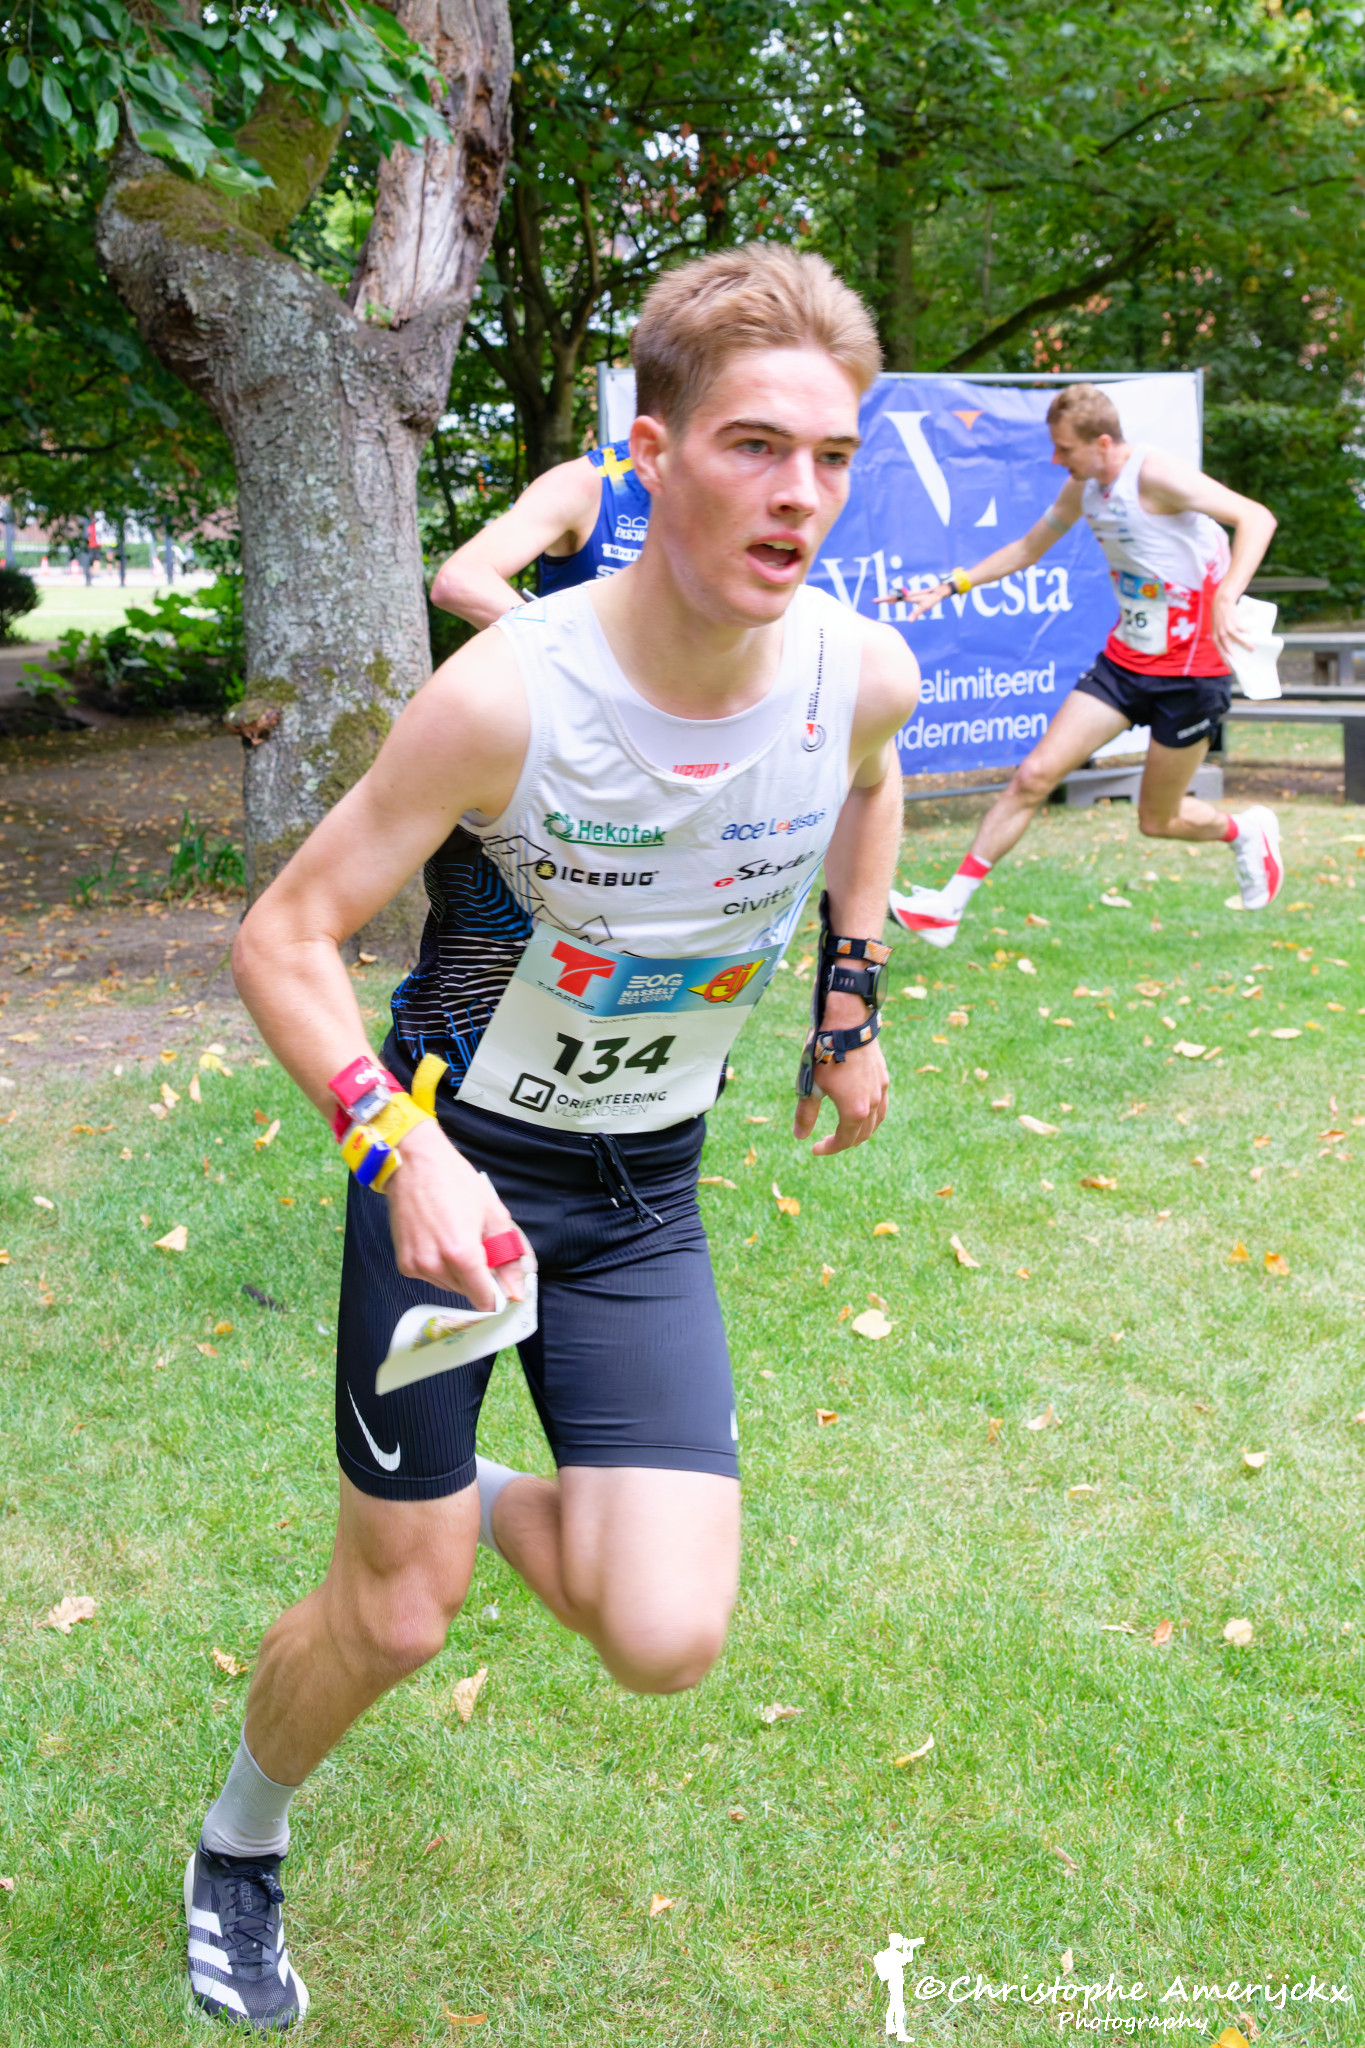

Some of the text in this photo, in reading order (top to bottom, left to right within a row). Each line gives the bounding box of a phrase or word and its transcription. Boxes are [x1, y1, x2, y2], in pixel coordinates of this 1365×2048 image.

[820, 549, 1073, 622] Vlinvesta
[919, 660, 1056, 704] elimiteerd
[578, 819, 667, 844] Hekotek
[720, 822, 766, 840] ace
[561, 866, 655, 887] ICEBUG
[617, 994, 674, 1006] BELGIUM
[621, 987, 679, 998] HASSELT
[553, 1032, 677, 1085] 134
[557, 1091, 667, 1110] ORIENTEERING
[554, 1104, 648, 1118] VLAANDEREN
